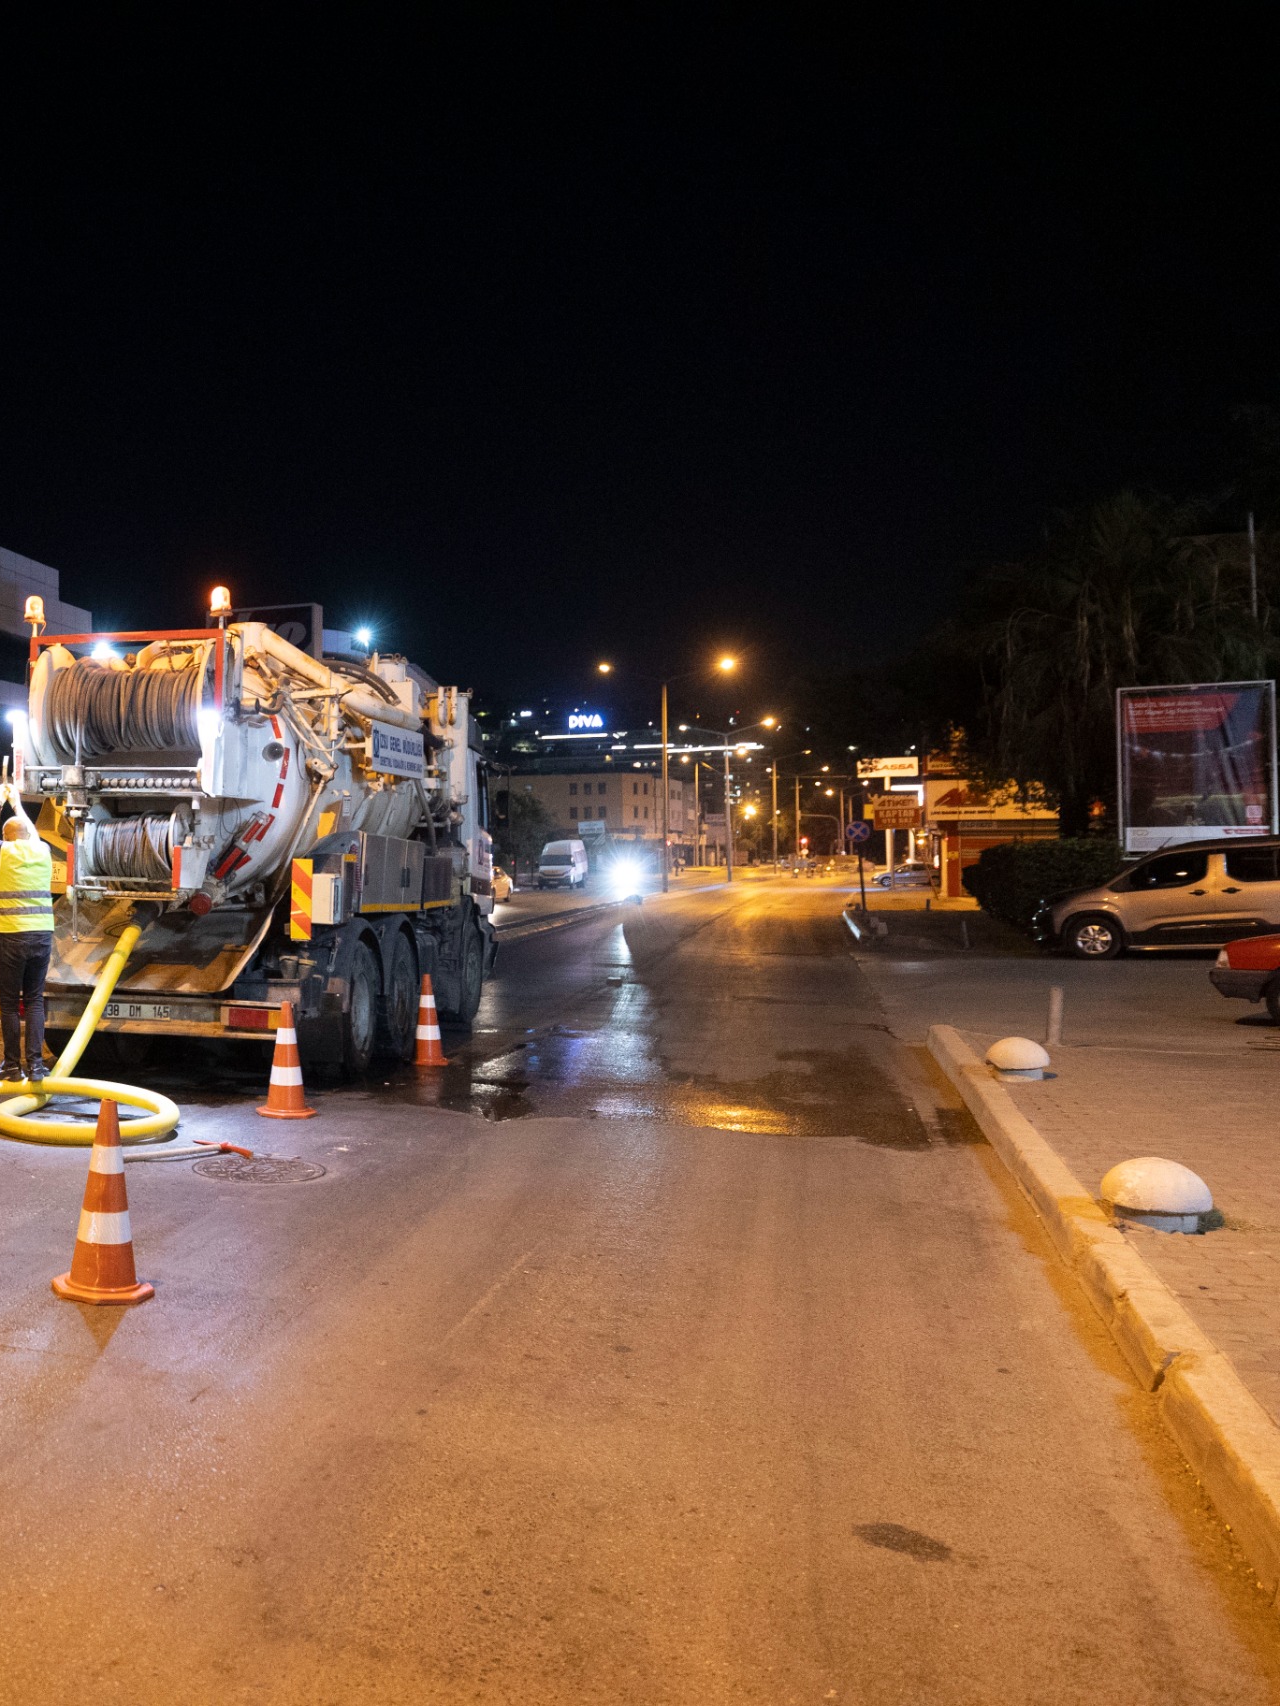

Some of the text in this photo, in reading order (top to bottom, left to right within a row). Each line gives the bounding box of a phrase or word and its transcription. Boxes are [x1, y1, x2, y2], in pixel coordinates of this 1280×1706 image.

[107, 1004, 169, 1018] 38 DM 145
